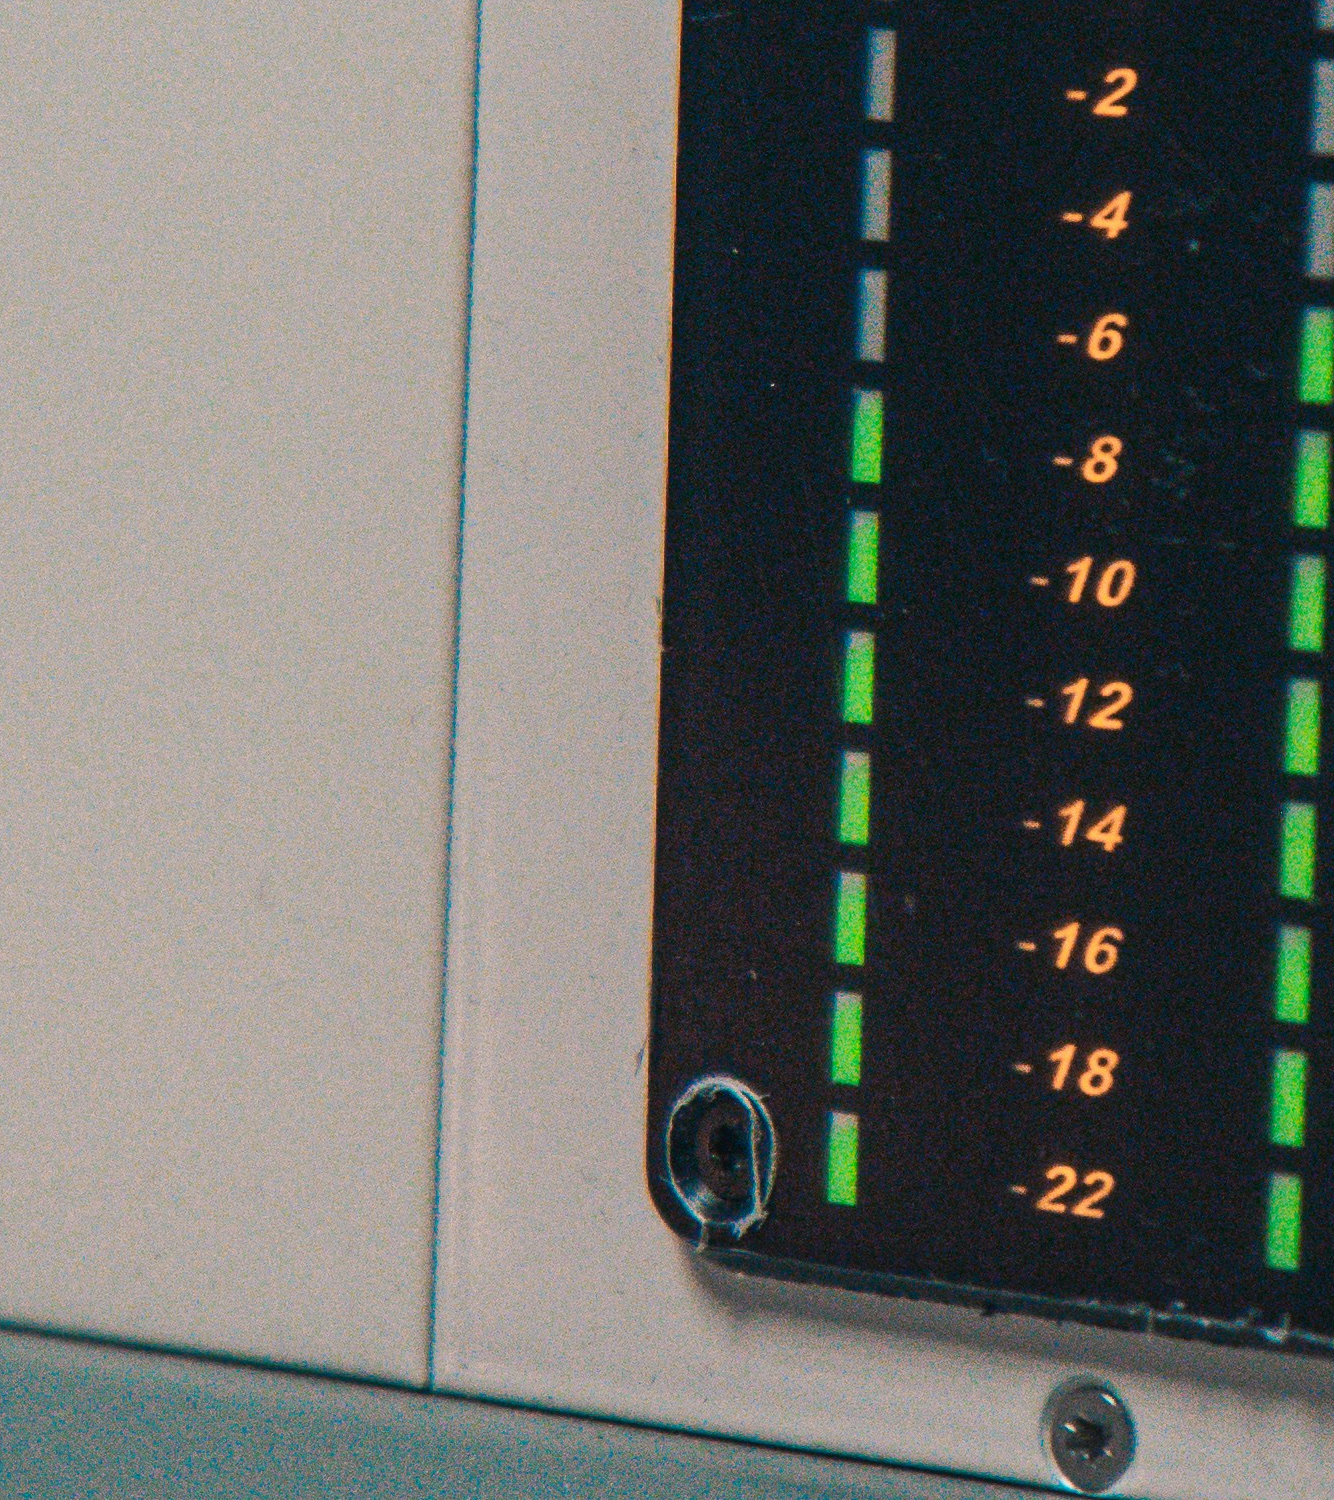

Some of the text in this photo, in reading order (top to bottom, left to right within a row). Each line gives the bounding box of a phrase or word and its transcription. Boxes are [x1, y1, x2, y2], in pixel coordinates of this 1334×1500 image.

[1064, 66, 1140, 119] -2
[1060, 189, 1133, 241] -4
[1056, 310, 1130, 363] -6
[1052, 434, 1124, 486] -8
[1029, 554, 1138, 610] -10
[1026, 676, 1135, 732] -12
[1021, 797, 1129, 854] -14
[1016, 919, 1125, 976] -16
[1012, 1041, 1122, 1099] -18
[1011, 1162, 1116, 1220] -22
